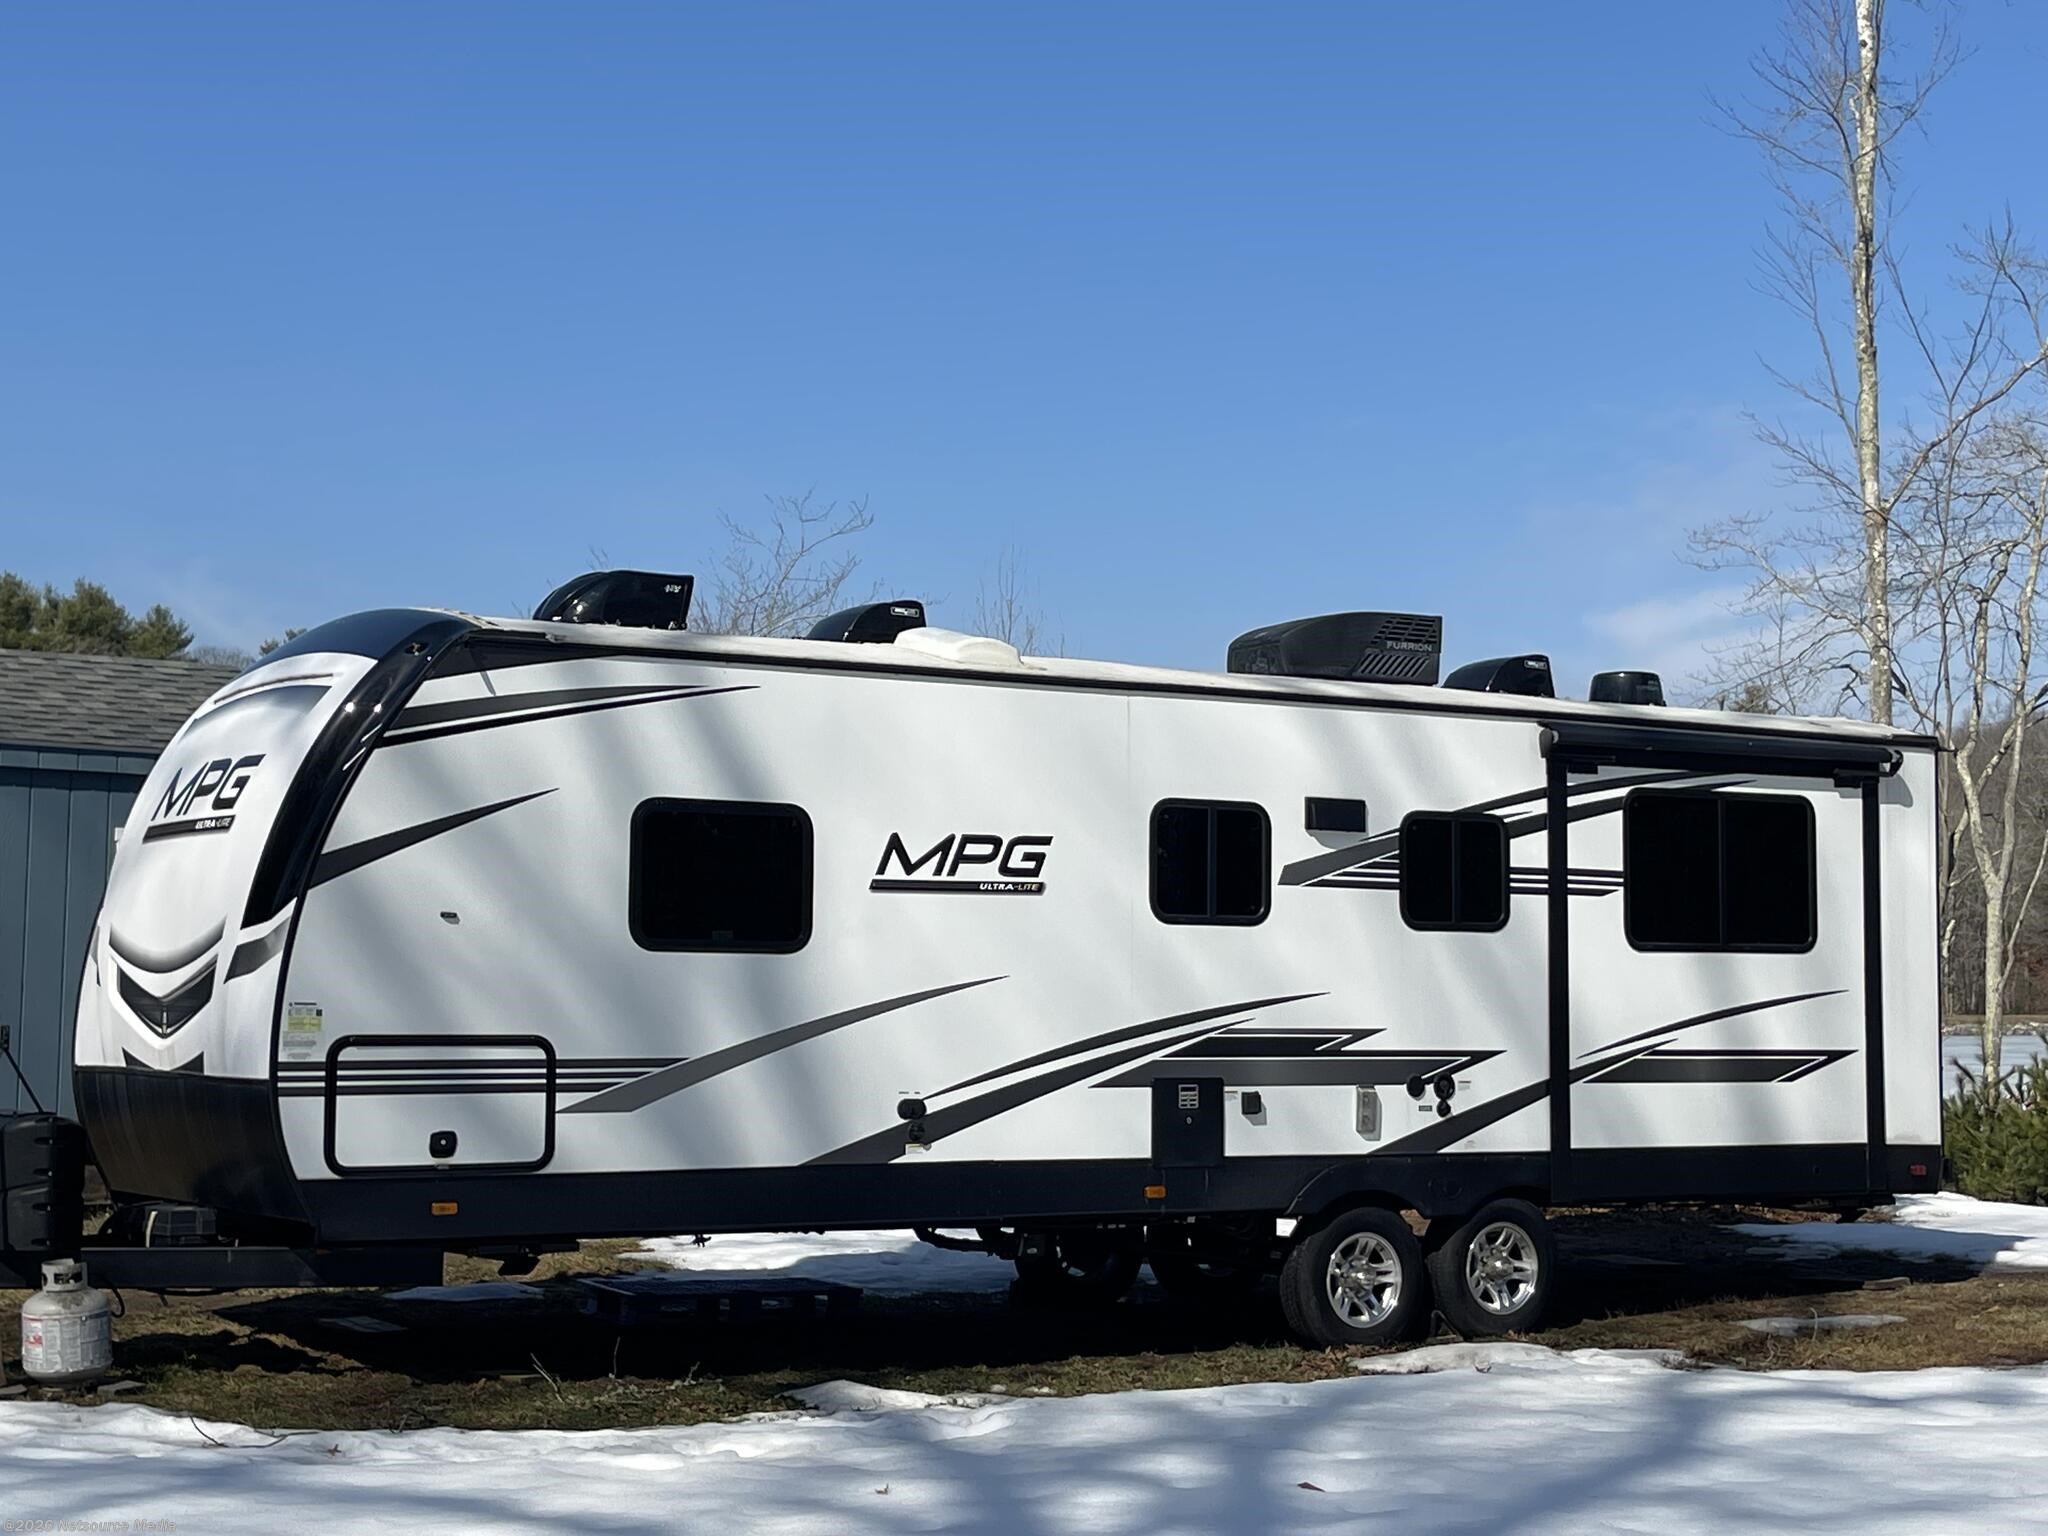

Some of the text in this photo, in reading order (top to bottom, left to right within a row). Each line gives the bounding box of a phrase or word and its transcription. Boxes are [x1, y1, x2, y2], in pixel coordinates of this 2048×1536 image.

[1386, 640, 1433, 651] FURRION
[150, 753, 267, 822] MPG
[874, 831, 1054, 878] MPG
[979, 882, 1040, 891] ULTRA-LITE
